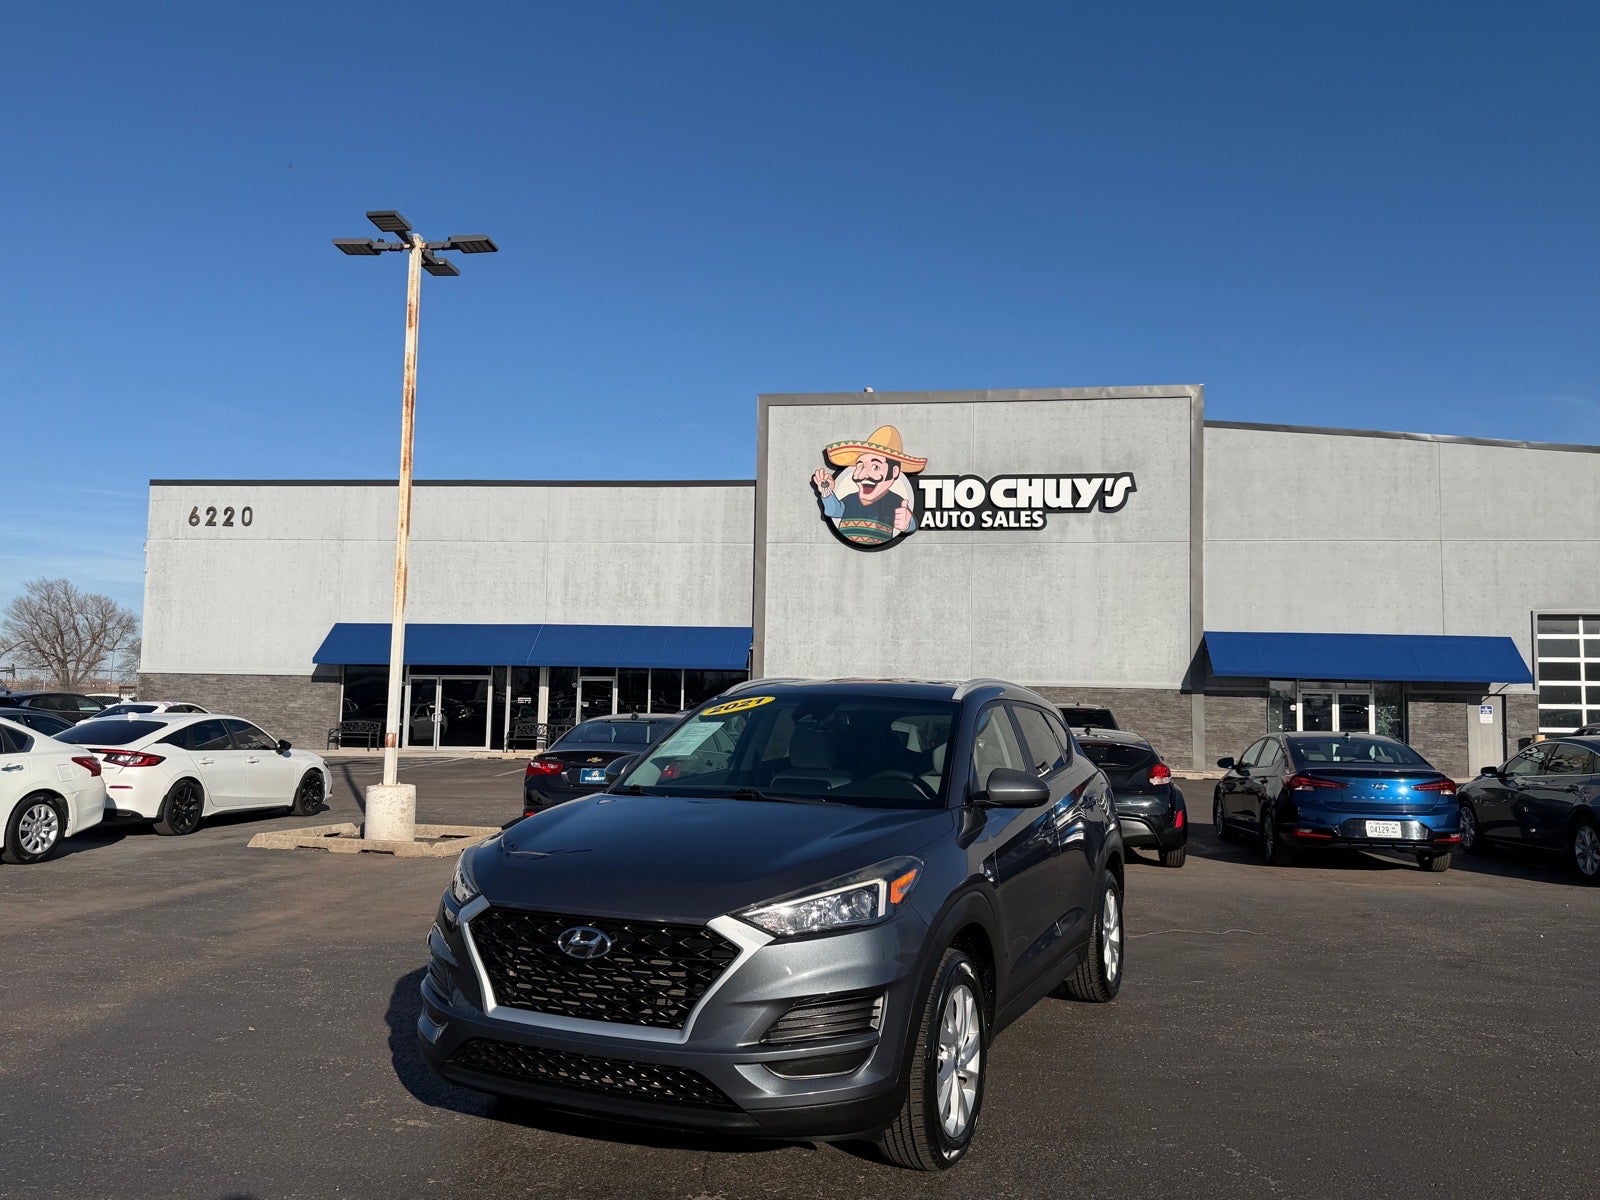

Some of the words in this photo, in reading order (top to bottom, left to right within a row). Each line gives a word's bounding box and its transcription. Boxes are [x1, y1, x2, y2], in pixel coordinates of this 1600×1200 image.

[918, 478, 986, 509] TIO
[989, 475, 1132, 509] CHUY'S
[188, 506, 253, 527] 6220
[920, 510, 975, 528] AUTO
[981, 510, 1044, 528] SALES
[706, 697, 766, 714] 2021
